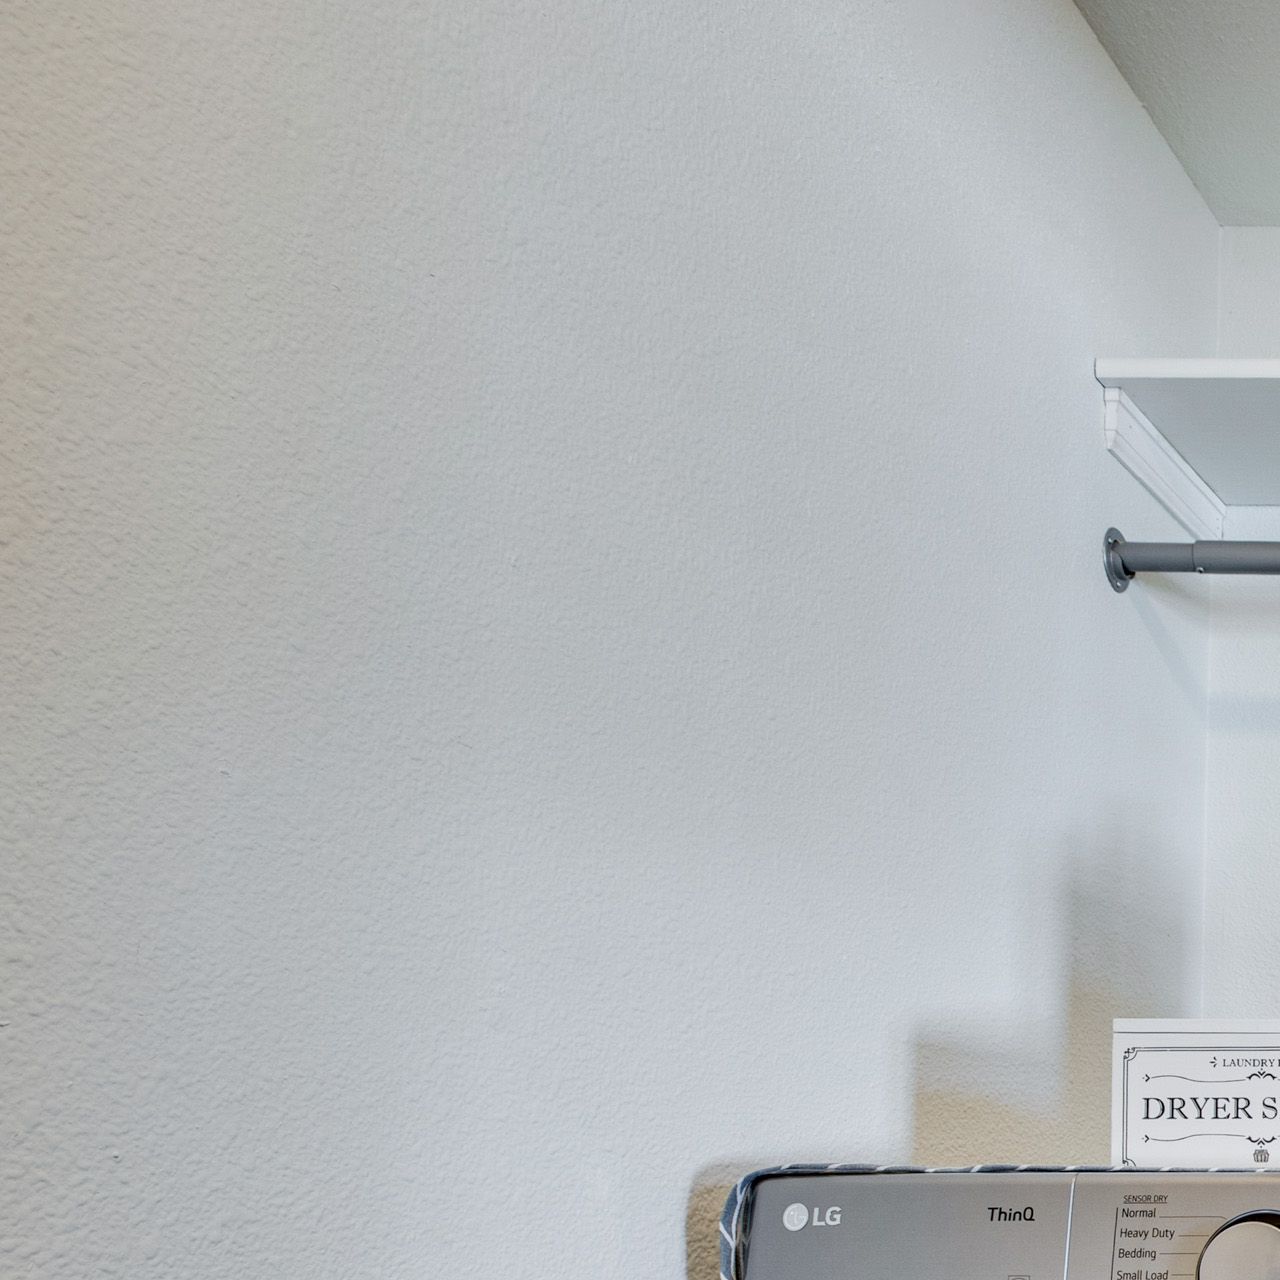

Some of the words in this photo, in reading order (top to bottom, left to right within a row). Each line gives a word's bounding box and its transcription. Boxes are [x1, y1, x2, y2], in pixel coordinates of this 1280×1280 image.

[1223, 1058, 1274, 1068] LAUNDRY
[1142, 1097, 1253, 1120] DRYER
[813, 1207, 842, 1226] LG
[988, 1207, 1035, 1222] ThinQ
[1122, 1208, 1156, 1218] Normal
[1120, 1228, 1149, 1240] Heavy
[1152, 1228, 1175, 1240] Duty
[1118, 1248, 1157, 1261] Bedding
[1116, 1270, 1143, 1280] Small
[1145, 1270, 1168, 1280] Load
